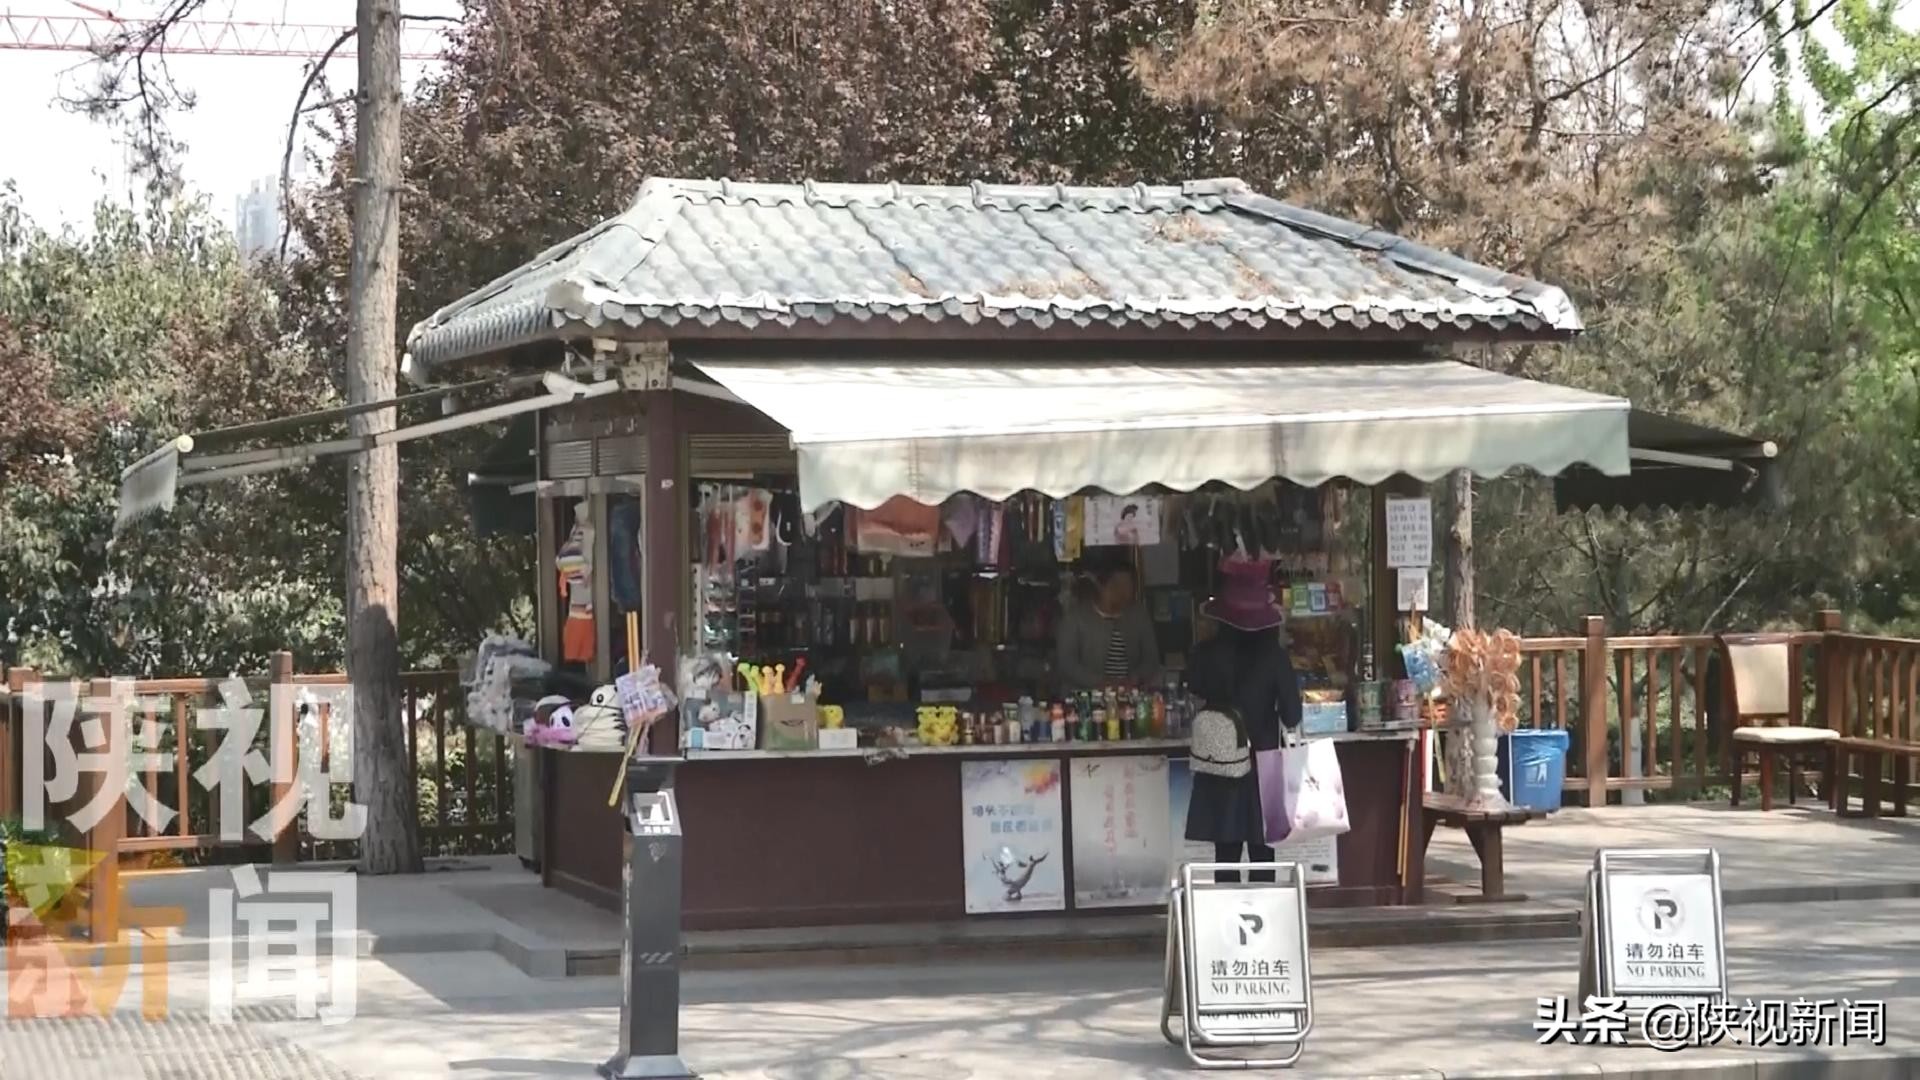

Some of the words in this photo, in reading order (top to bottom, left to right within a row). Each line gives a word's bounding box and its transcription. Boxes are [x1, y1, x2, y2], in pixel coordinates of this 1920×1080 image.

[1626, 943, 1705, 961] 请勿泊车
[1211, 959, 1290, 977] 请勿泊车
[1626, 965, 1645, 977] NO
[1650, 965, 1705, 979] PARKING
[1211, 980, 1229, 995] NO
[1235, 980, 1290, 996] PARKING
